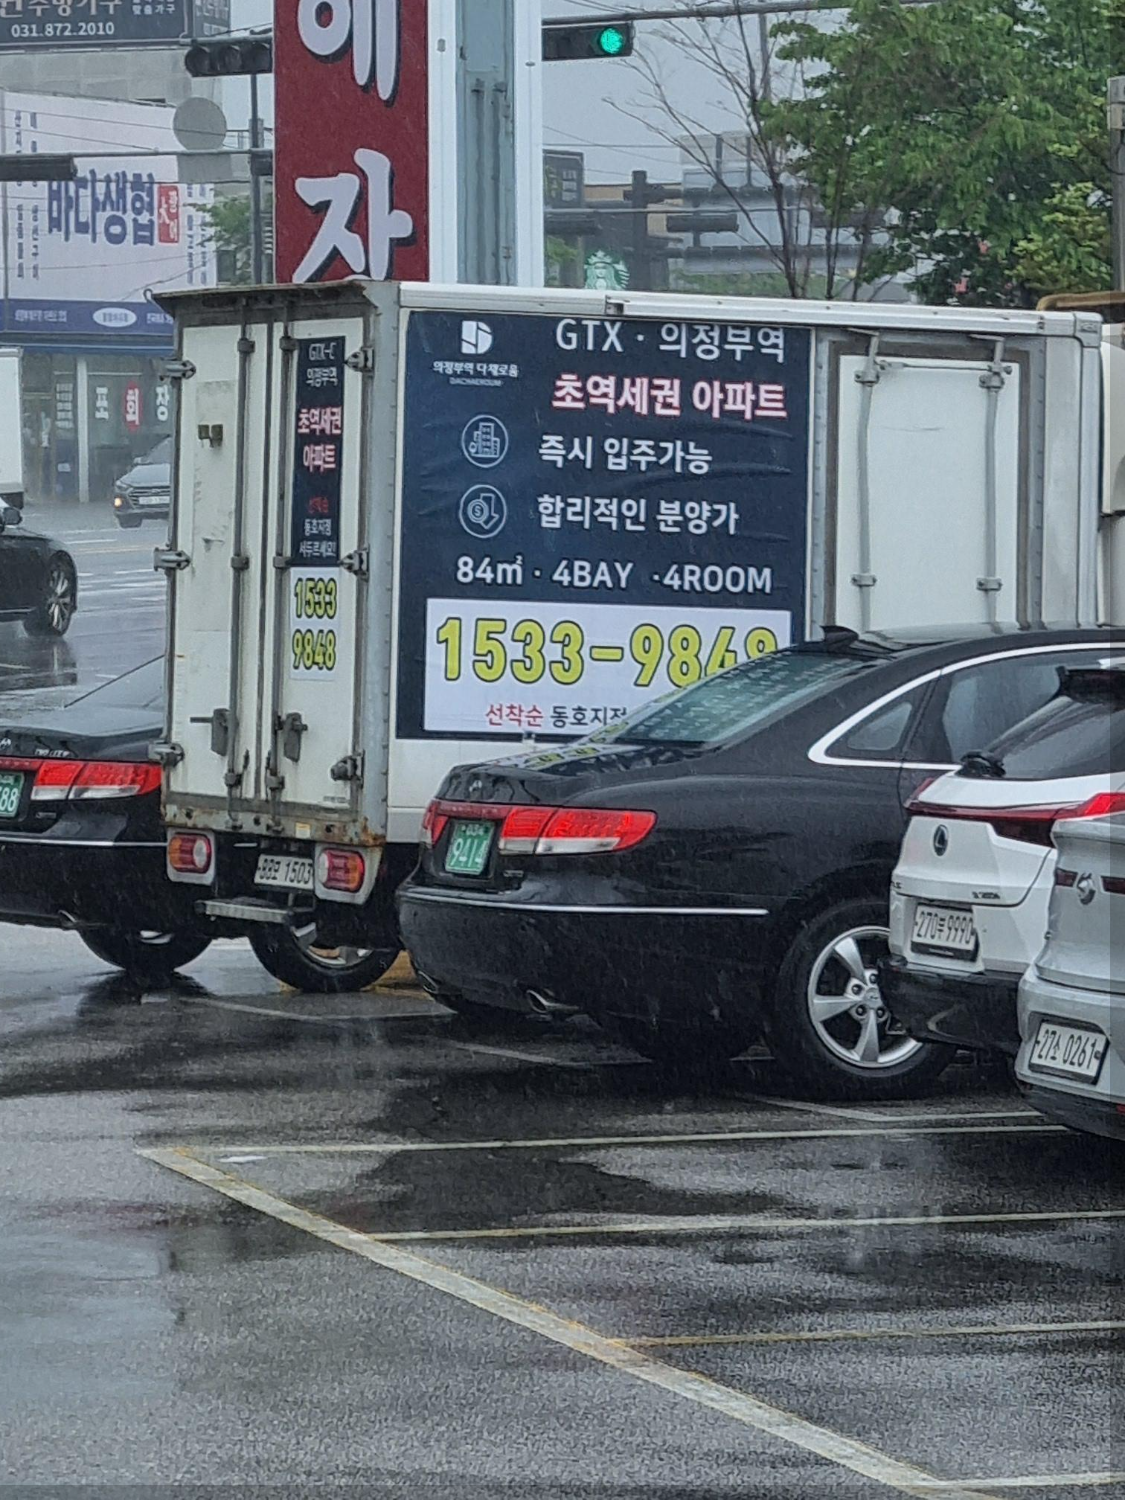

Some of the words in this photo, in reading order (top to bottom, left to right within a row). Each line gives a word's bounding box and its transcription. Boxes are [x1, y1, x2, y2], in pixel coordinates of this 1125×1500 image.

[11, 22, 115, 38] 031.872.2010
[47, 168, 155, 246] 바다생협
[556, 318, 624, 352] GTX
[658, 322, 785, 363] 의정부역
[551, 373, 682, 418] 초역세권
[691, 379, 788, 420] 아파트
[298, 406, 342, 435] 초역세권
[303, 444, 336, 472] 아파트
[538, 434, 593, 468] 즉시
[603, 437, 713, 475] 입주가능
[537, 494, 646, 531] 합리적인
[655, 499, 739, 535] 분양가
[552, 560, 634, 589] 4BAY
[295, 578, 338, 619] 1533
[292, 628, 337, 671] 9848
[485, 703, 544, 728] 선착순
[1063, 1033, 1098, 1069] 0261
